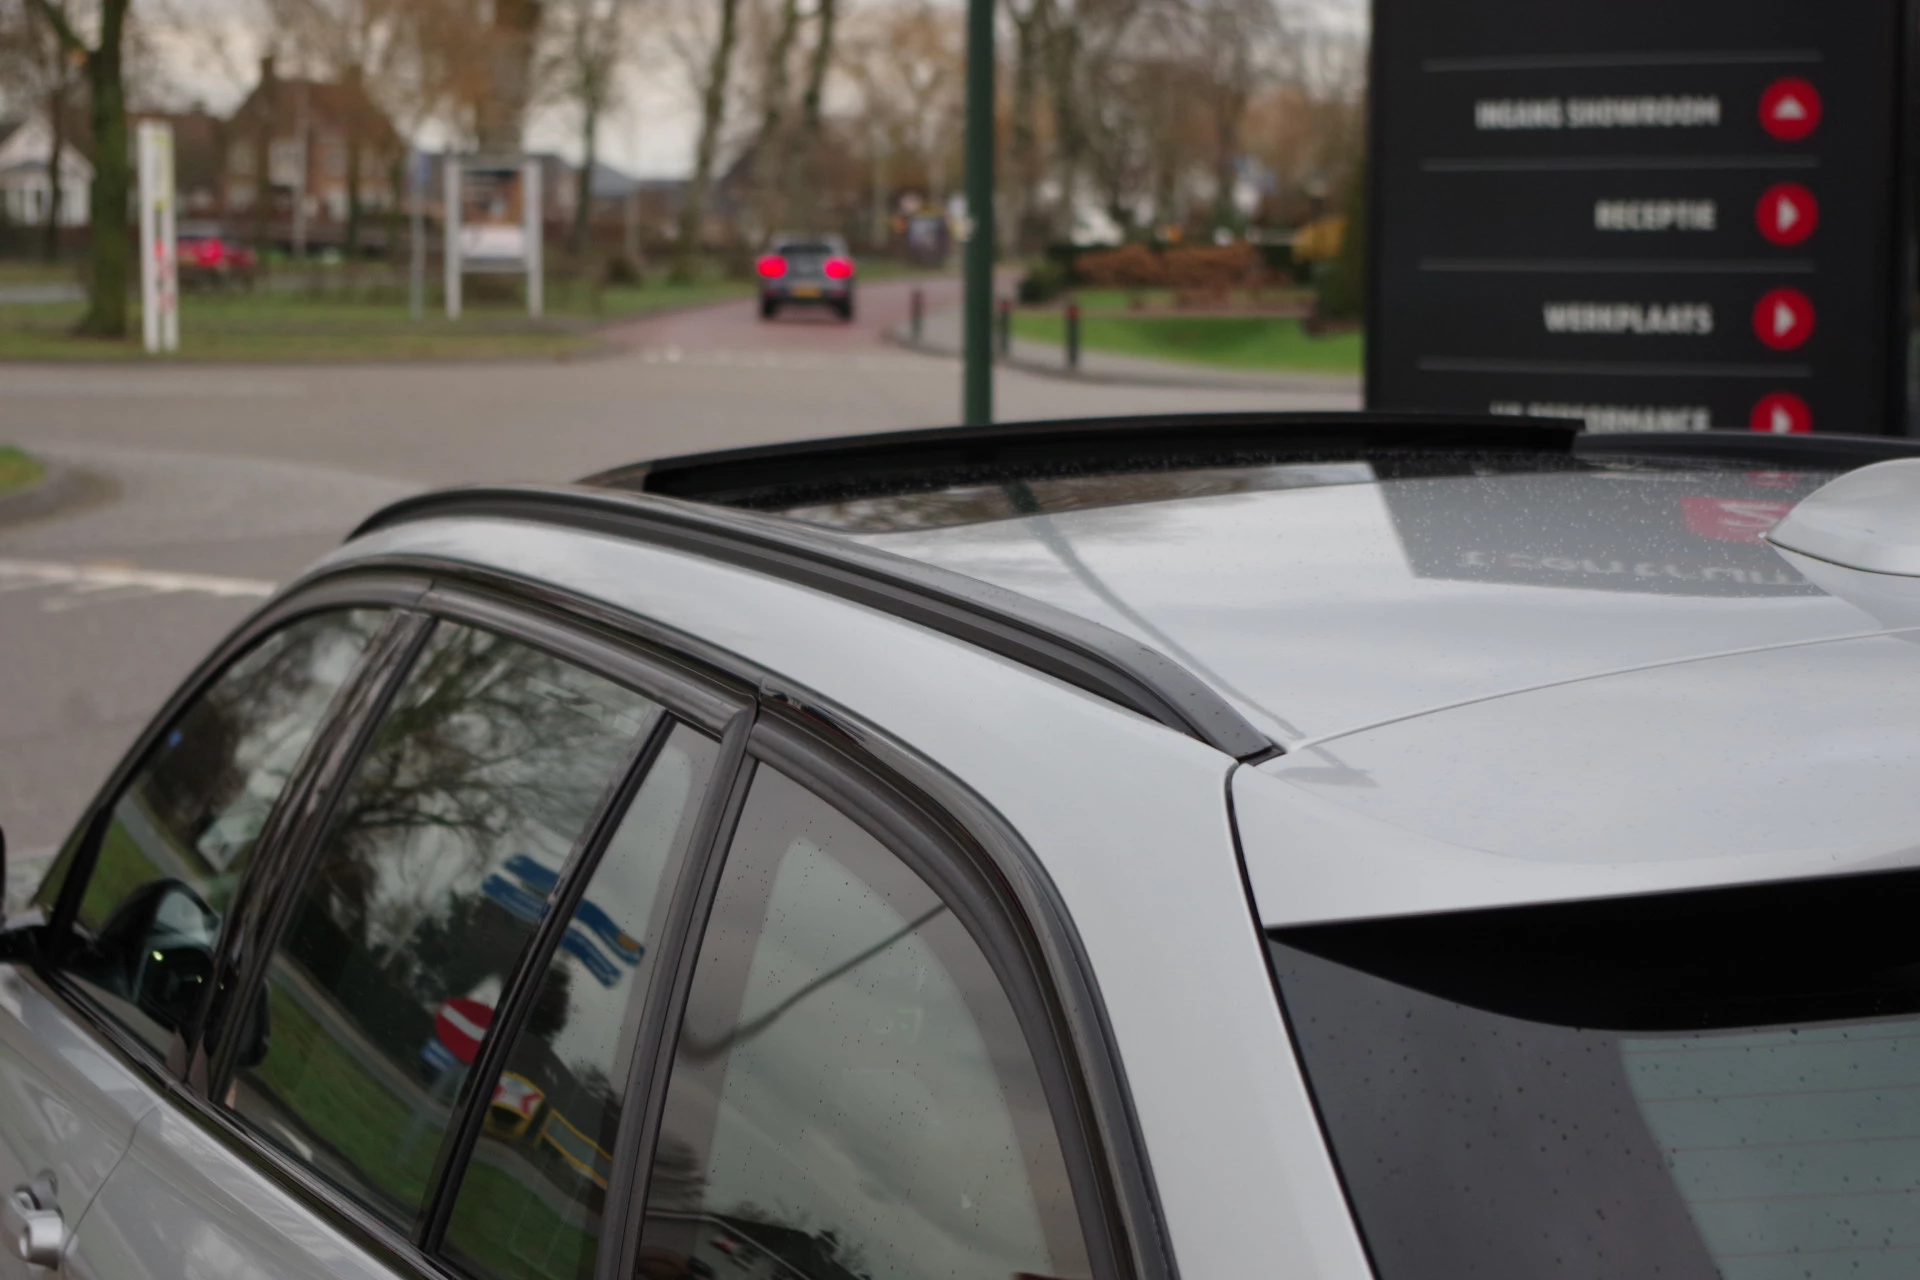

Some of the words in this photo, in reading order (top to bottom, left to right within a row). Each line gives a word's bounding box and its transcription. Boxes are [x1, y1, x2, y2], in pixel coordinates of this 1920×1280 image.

[1475, 99, 1564, 129] INGANG
[1566, 96, 1720, 127] SHOWROOM
[1594, 200, 1716, 230] RECEPTIE
[1543, 303, 1713, 334] WERKPLAATS
